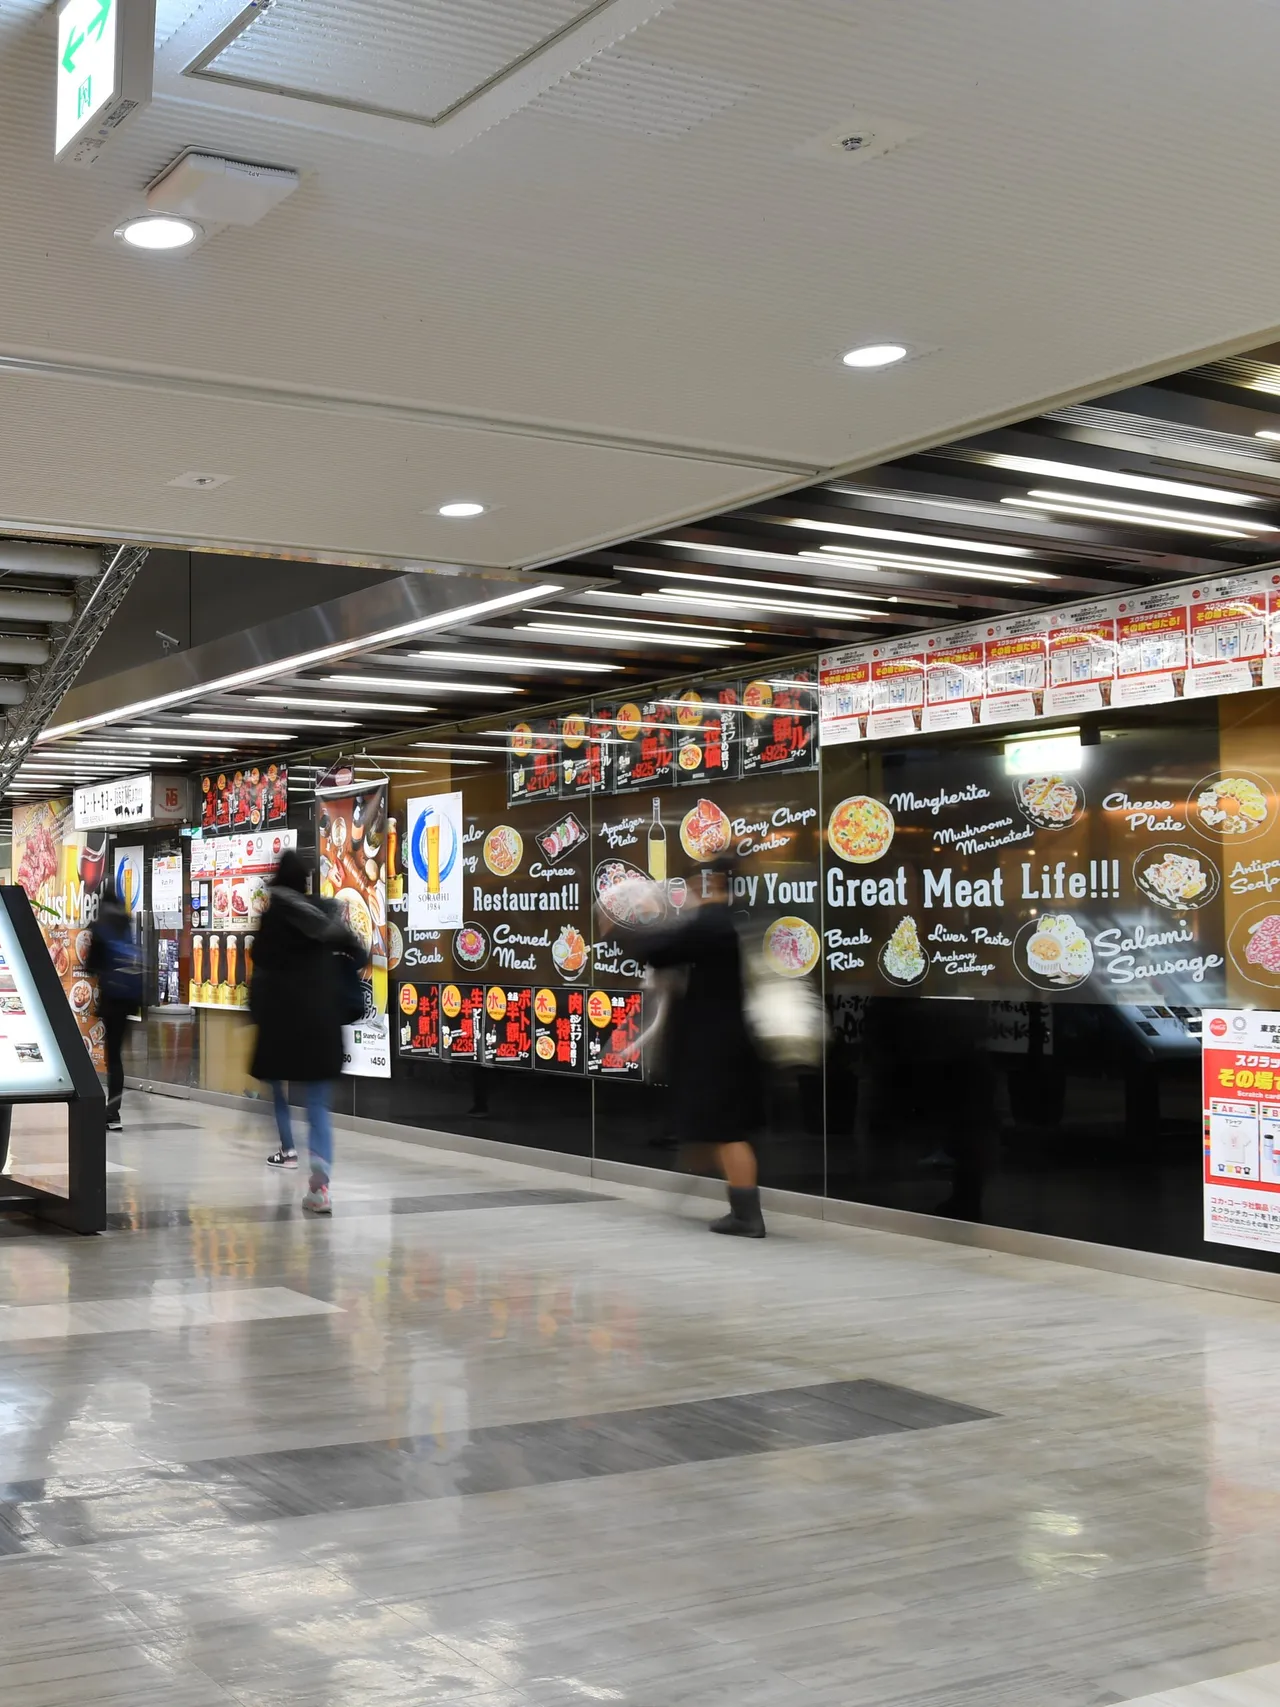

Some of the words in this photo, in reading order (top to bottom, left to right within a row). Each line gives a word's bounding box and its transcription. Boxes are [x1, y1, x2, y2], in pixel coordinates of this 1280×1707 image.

[889, 784, 990, 815] Margherita
[1102, 793, 1174, 811] Cheese
[598, 818, 645, 837] Appetizer
[731, 818, 769, 838] Bony
[771, 807, 816, 827] Chops
[933, 816, 1013, 845] Mushrooms
[1125, 813, 1187, 832] Plate
[607, 834, 638, 848] Plate
[737, 833, 790, 856] Combo
[956, 824, 1035, 856] Marinated
[529, 863, 576, 881] Caprese
[701, 868, 759, 906] Ejoy
[764, 873, 817, 904] Your
[827, 866, 908, 907] Great
[923, 867, 1005, 908] Meat
[1021, 859, 1120, 899] Life!!!
[38, 883, 67, 926] Just
[427, 901, 441, 911] 1984
[473, 883, 579, 911] Restaurant!!
[493, 924, 551, 947] Corned
[824, 928, 872, 949] Back
[927, 924, 968, 942] Liver
[971, 927, 1012, 946] Paste
[1094, 920, 1193, 957] Salami
[404, 947, 443, 966] Steak
[493, 947, 536, 970] Meat
[592, 941, 623, 959] Fish
[931, 951, 977, 964] Anchovy
[594, 958, 620, 973] and
[620, 959, 648, 979] Chi
[826, 952, 865, 971] Ribs
[945, 962, 995, 976] Cabbage
[1107, 954, 1224, 984] Sausage
